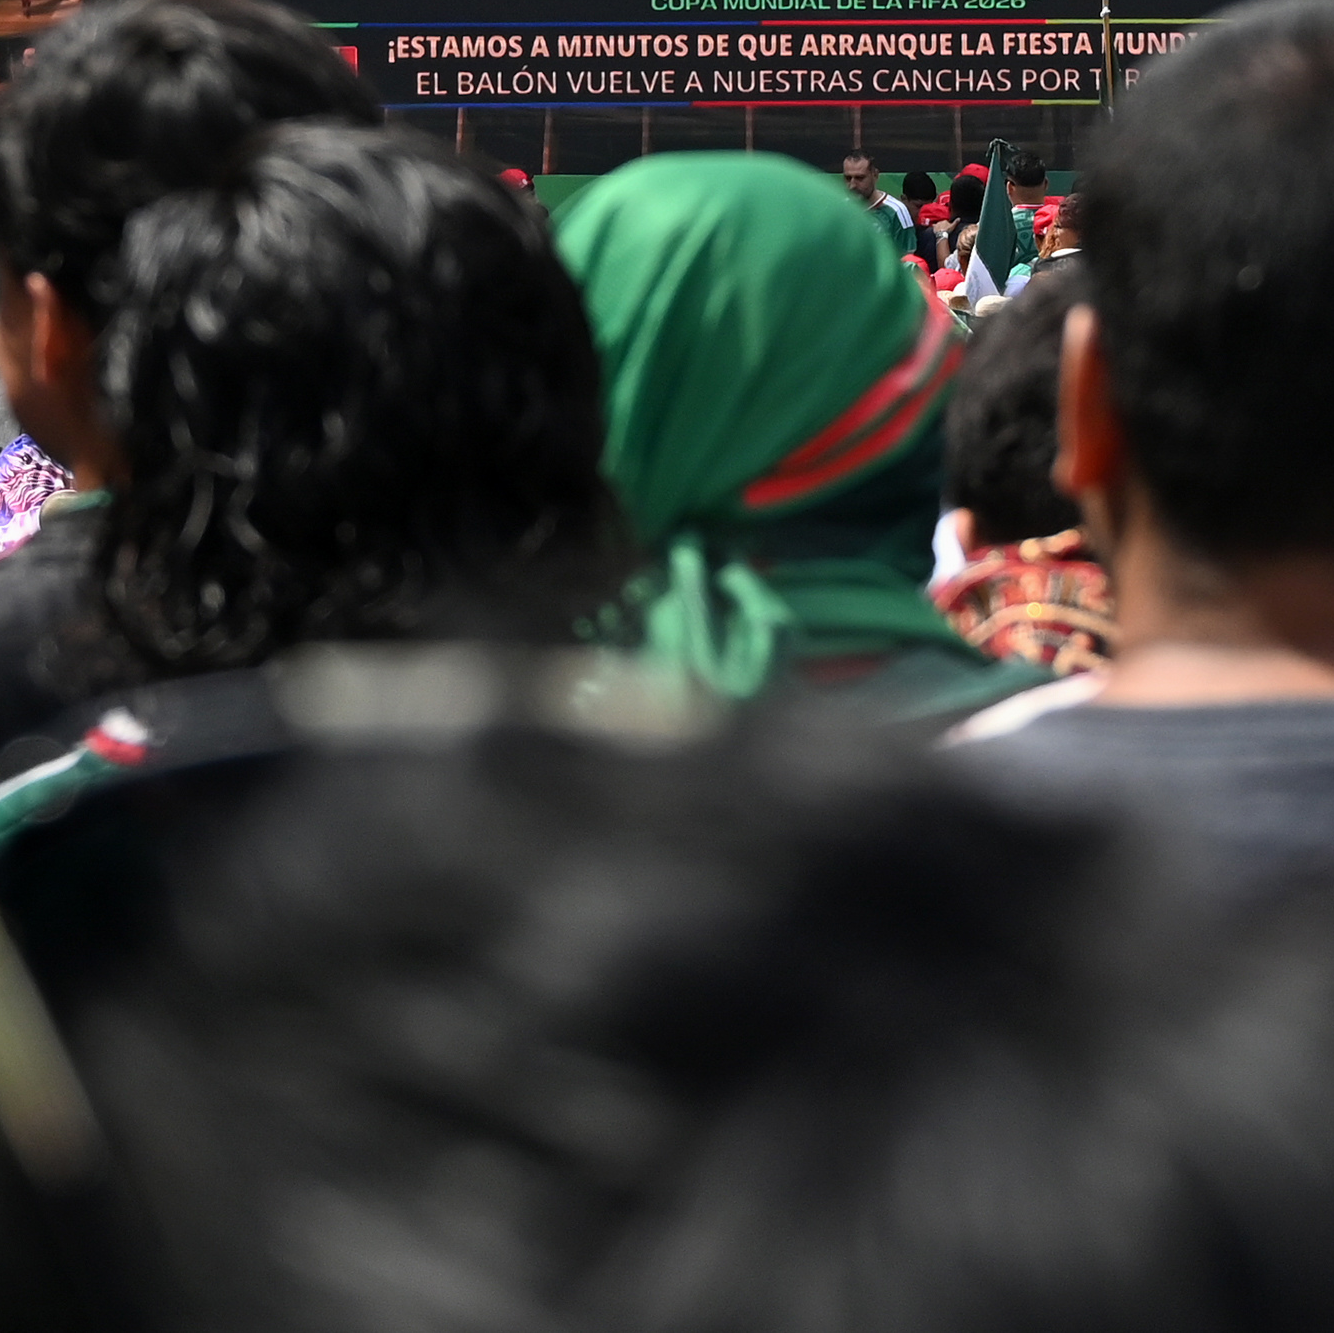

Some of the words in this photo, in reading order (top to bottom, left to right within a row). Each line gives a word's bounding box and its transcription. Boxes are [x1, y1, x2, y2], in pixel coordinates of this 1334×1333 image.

[388, 35, 524, 63] ¡ESTAMOS
[530, 35, 551, 58] A
[557, 34, 689, 58] MINUTOS
[696, 33, 730, 57] DE
[737, 33, 793, 61] QUE
[800, 32, 954, 60] ARRANQUE
[961, 32, 996, 57] LA
[1003, 32, 1094, 57] FIESTA
[416, 72, 448, 96] EL
[457, 65, 558, 95] BALÓN
[566, 70, 676, 94] VUELVE
[684, 71, 705, 94] A
[713, 69, 863, 93] NUESTRAS
[872, 68, 1012, 92] CANCHAS
[1022, 68, 1080, 91] POR
